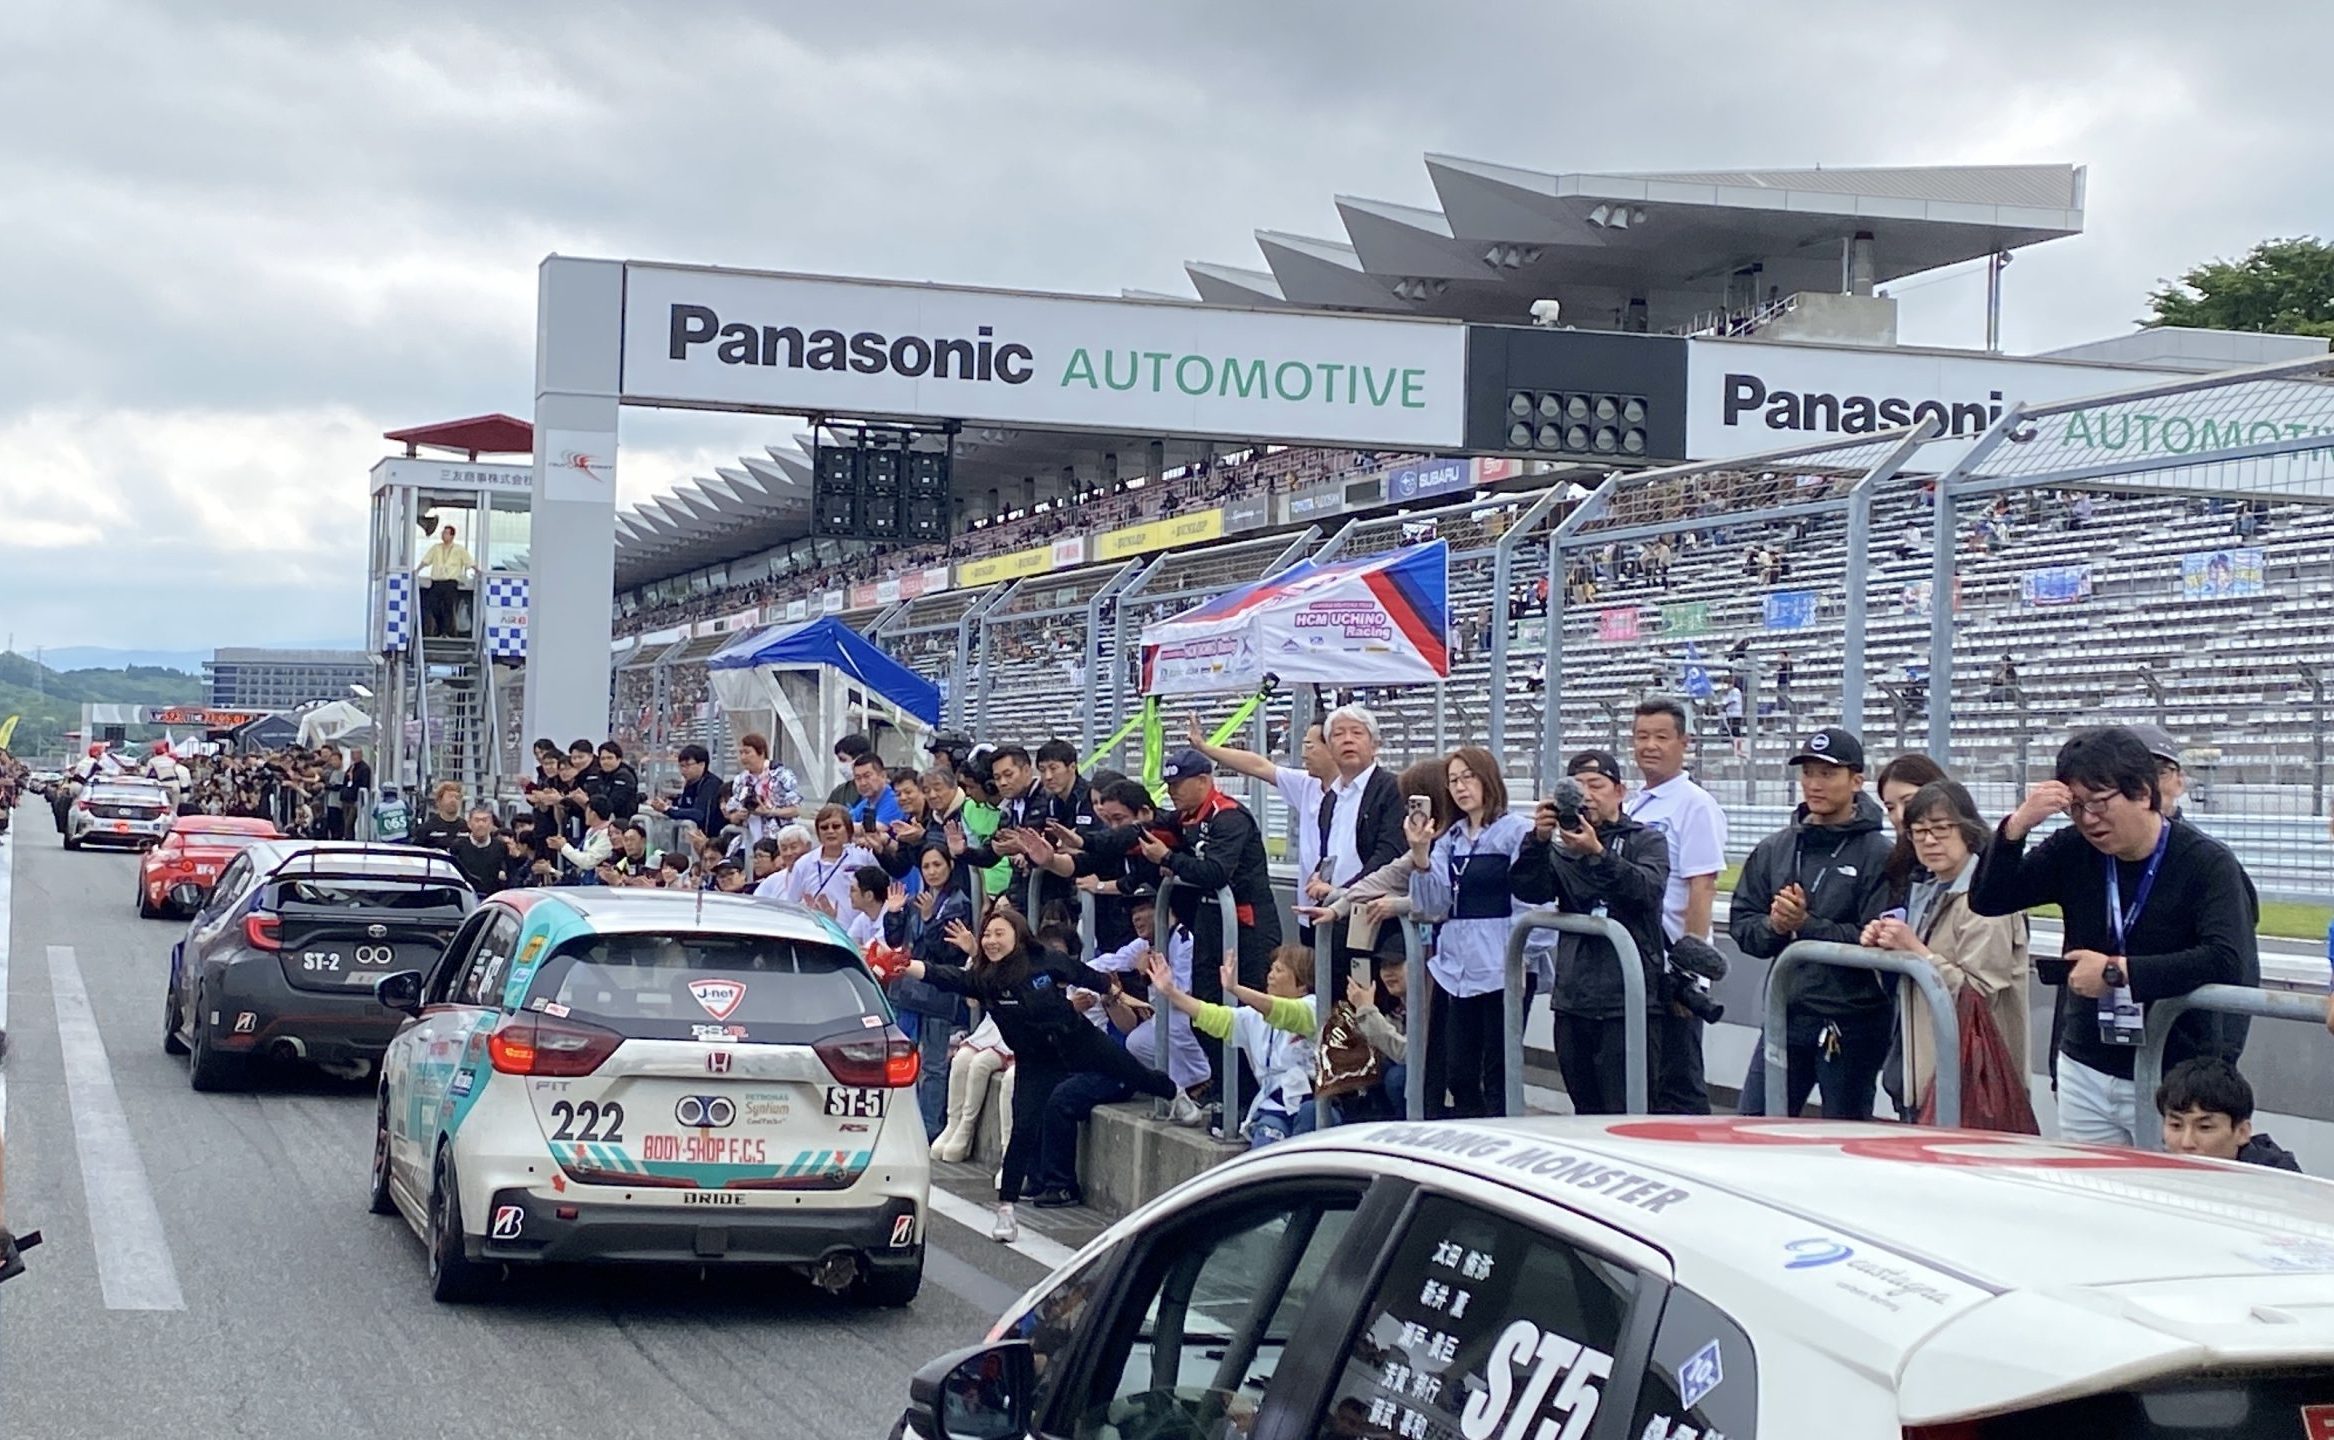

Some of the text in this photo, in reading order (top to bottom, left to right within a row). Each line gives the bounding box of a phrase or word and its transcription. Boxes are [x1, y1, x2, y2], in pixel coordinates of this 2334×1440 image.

[669, 303, 1427, 409] Panasonic AUTOMOTIVE
[1418, 466, 1460, 488] SUBARU
[1176, 520, 1207, 537] DUNLOP
[1118, 533, 1146, 549] DUNLOP
[1295, 611, 1386, 627] HCM UCHINO
[1344, 626, 1392, 641] Racing
[384, 815, 407, 830] 065
[303, 952, 340, 971] ST-2
[696, 987, 734, 998] J-net
[535, 1081, 571, 1091] FIT
[829, 1088, 880, 1117] ST-5
[551, 1100, 624, 1142] 222
[839, 1124, 868, 1132] RS
[1495, 1147, 1691, 1214] MONSTER
[684, 1192, 746, 1205] BRIDE
[1460, 1319, 1614, 1440] ST5
